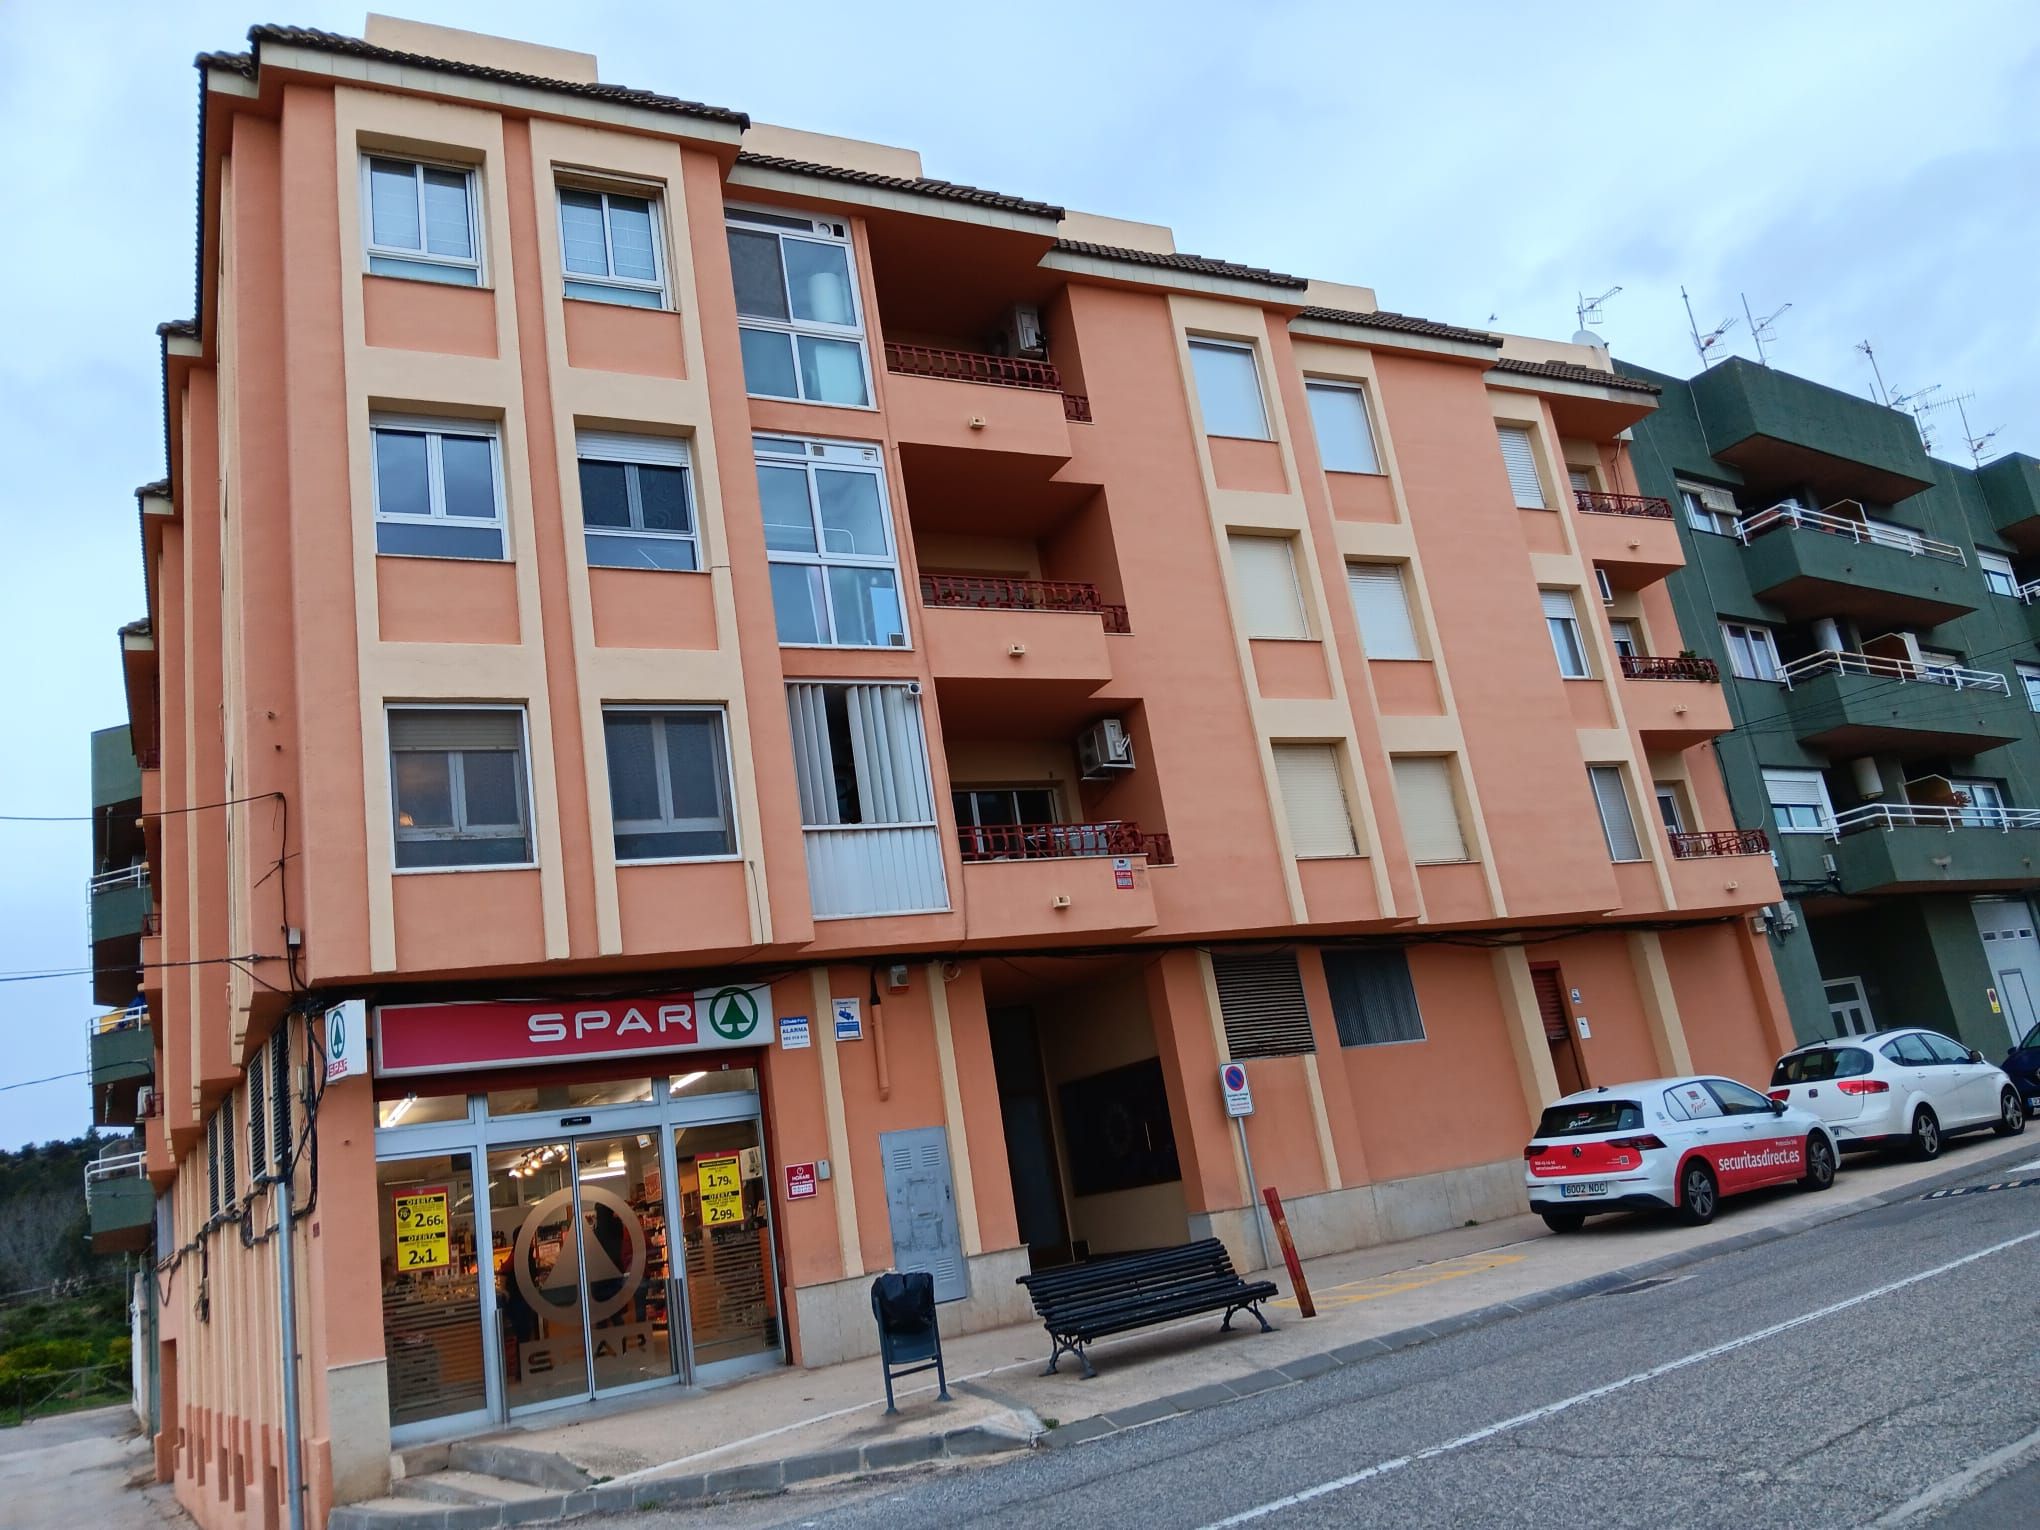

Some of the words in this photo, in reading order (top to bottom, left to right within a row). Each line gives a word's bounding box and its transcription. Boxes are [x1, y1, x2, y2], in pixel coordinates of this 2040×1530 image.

[528, 1004, 693, 1043] SPAR
[1718, 1147, 1801, 1172] securitasdirect.es
[1566, 1184, 1586, 1194] 6002
